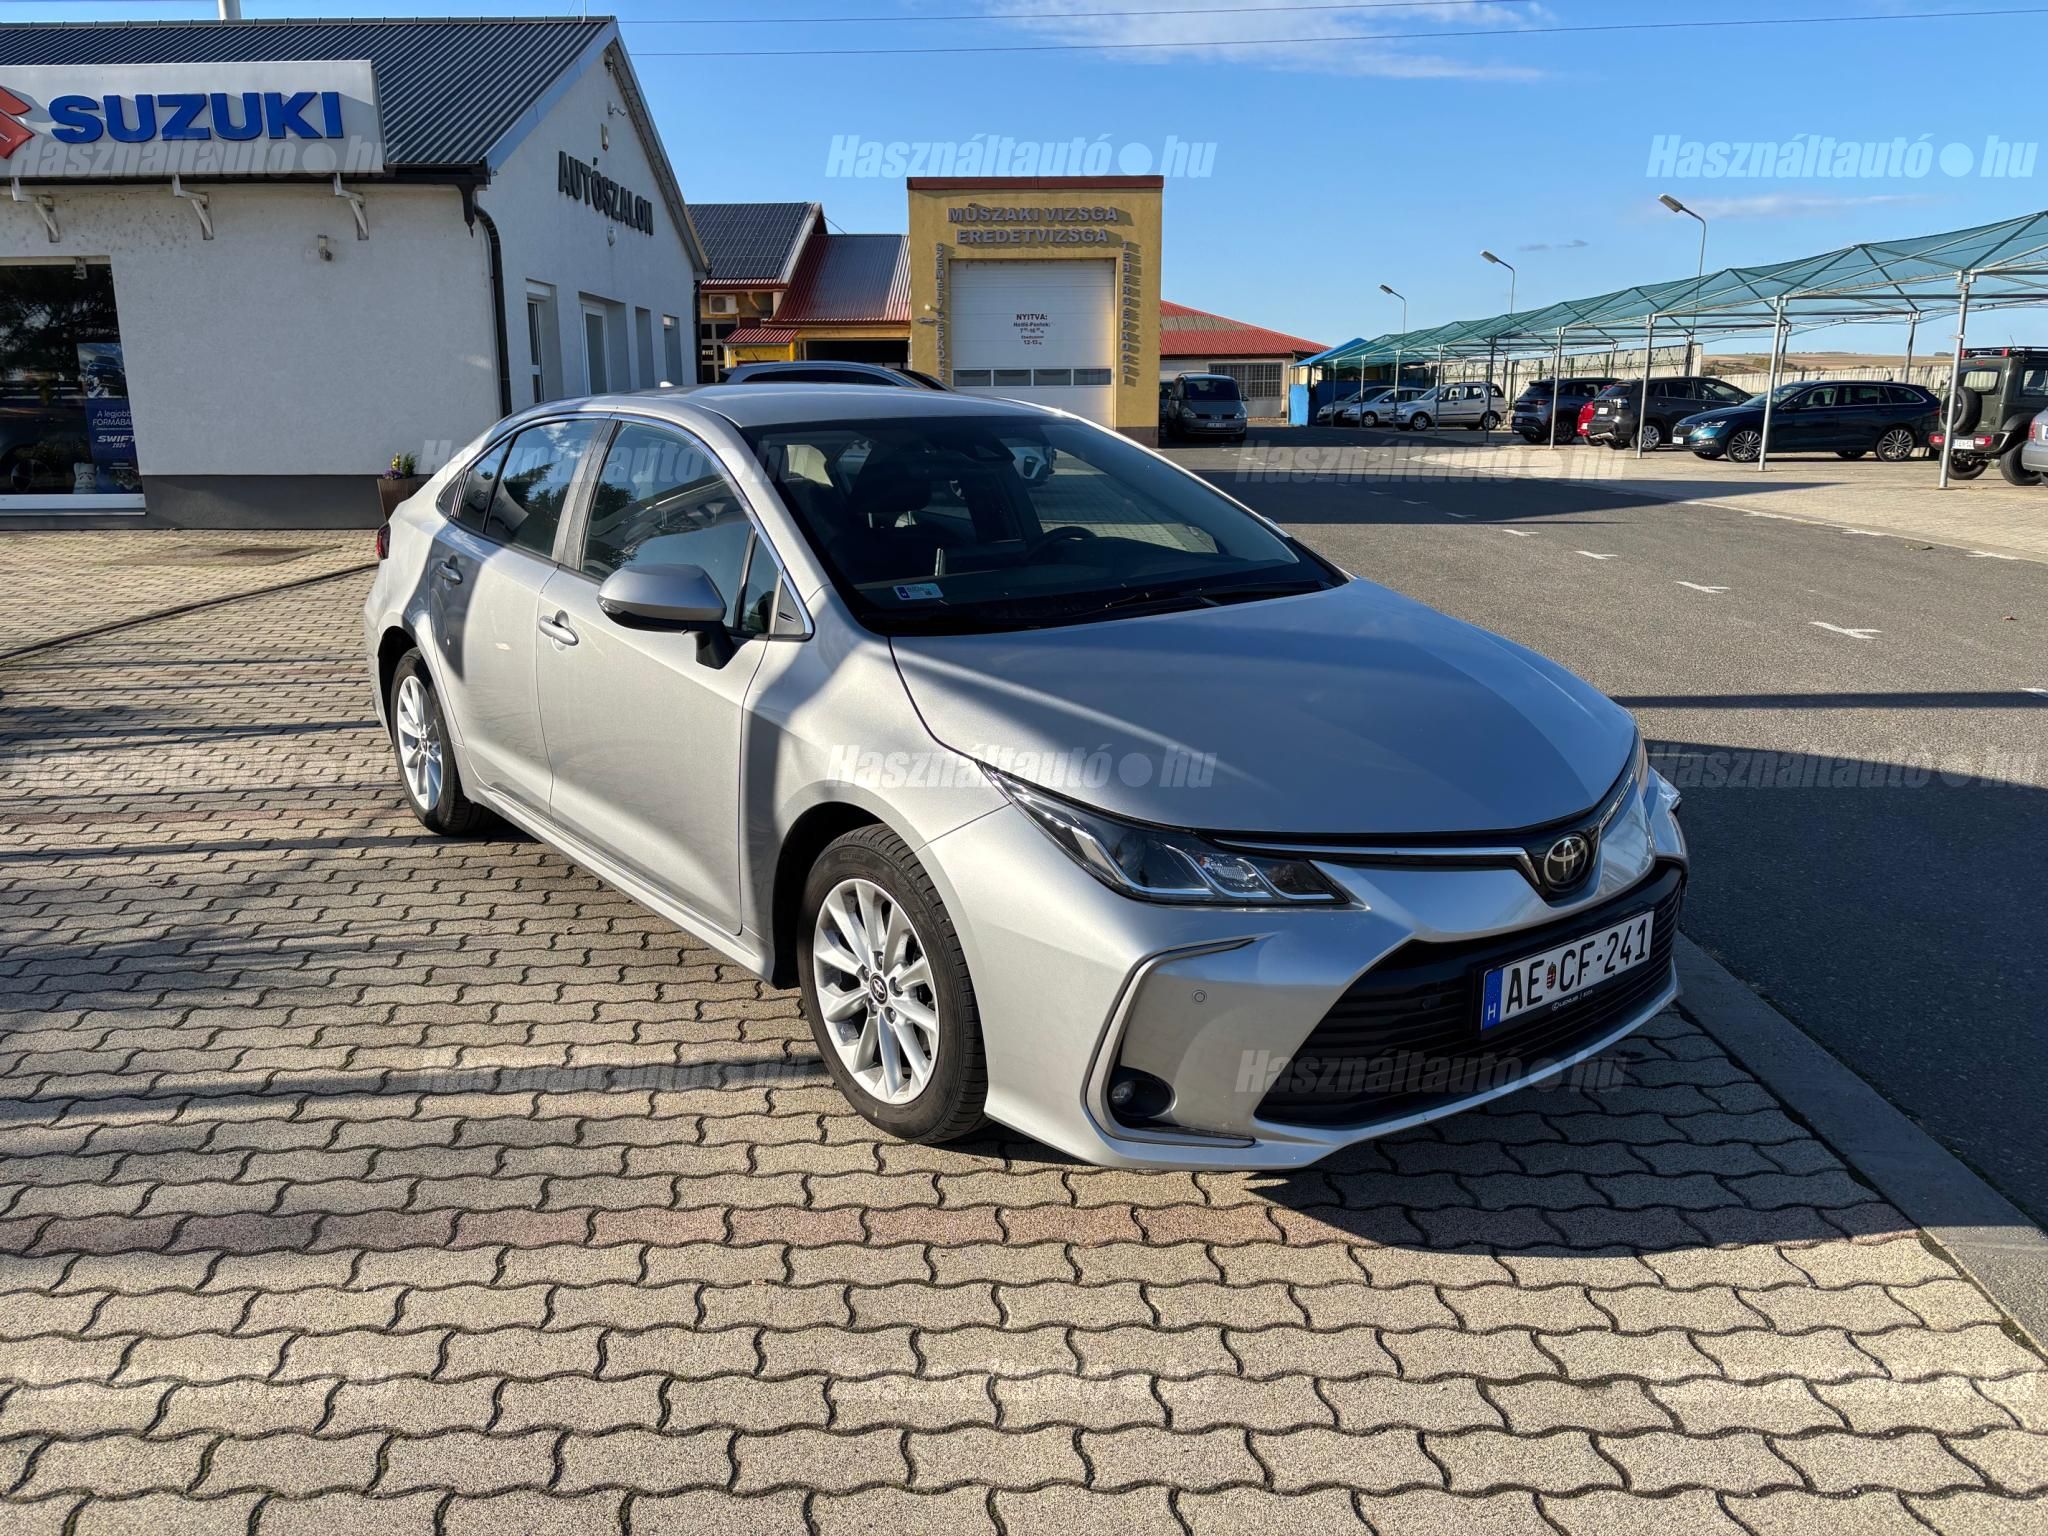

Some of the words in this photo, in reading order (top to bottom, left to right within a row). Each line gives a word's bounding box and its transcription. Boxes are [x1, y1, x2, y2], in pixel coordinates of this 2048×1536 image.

[48, 91, 345, 144] SUZUKI
[558, 150, 654, 237] AUTÓSZALON
[948, 202, 1039, 223] MŰSZAKI
[1043, 206, 1119, 222] VIZSGA
[956, 228, 1109, 244] EREDETVIZSGA
[1505, 959, 1546, 1014] AE
[1559, 919, 1648, 992] CF-241
[1487, 1003, 1497, 1021] H
